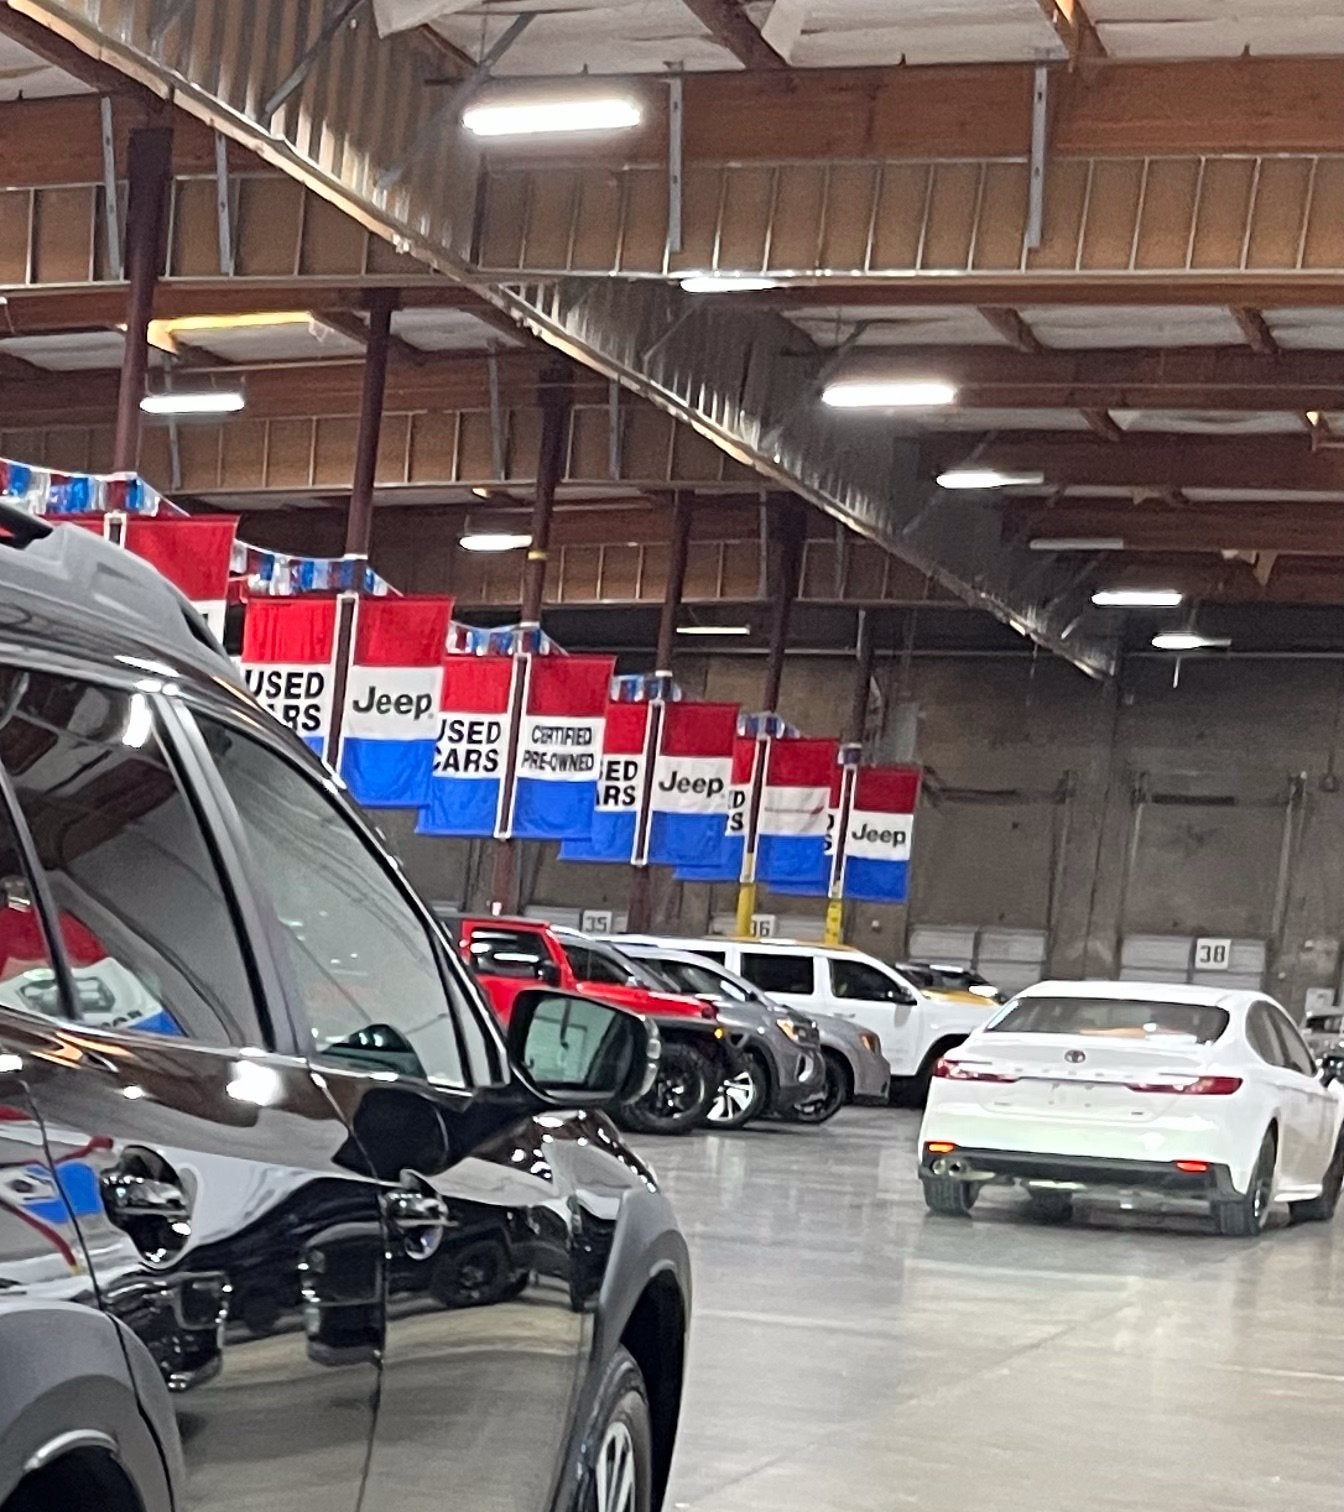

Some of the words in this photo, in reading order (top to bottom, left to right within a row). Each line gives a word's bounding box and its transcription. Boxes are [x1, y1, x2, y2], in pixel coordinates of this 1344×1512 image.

[245, 669, 325, 700] USED
[352, 686, 433, 721] Jeep
[268, 703, 322, 732] RS
[532, 725, 593, 746] CERTIFIED
[521, 750, 594, 772] PRE-OWNED
[599, 760, 638, 782] ED
[596, 784, 636, 807] RS
[658, 770, 725, 799] Jeep
[851, 823, 907, 848] Jeep
